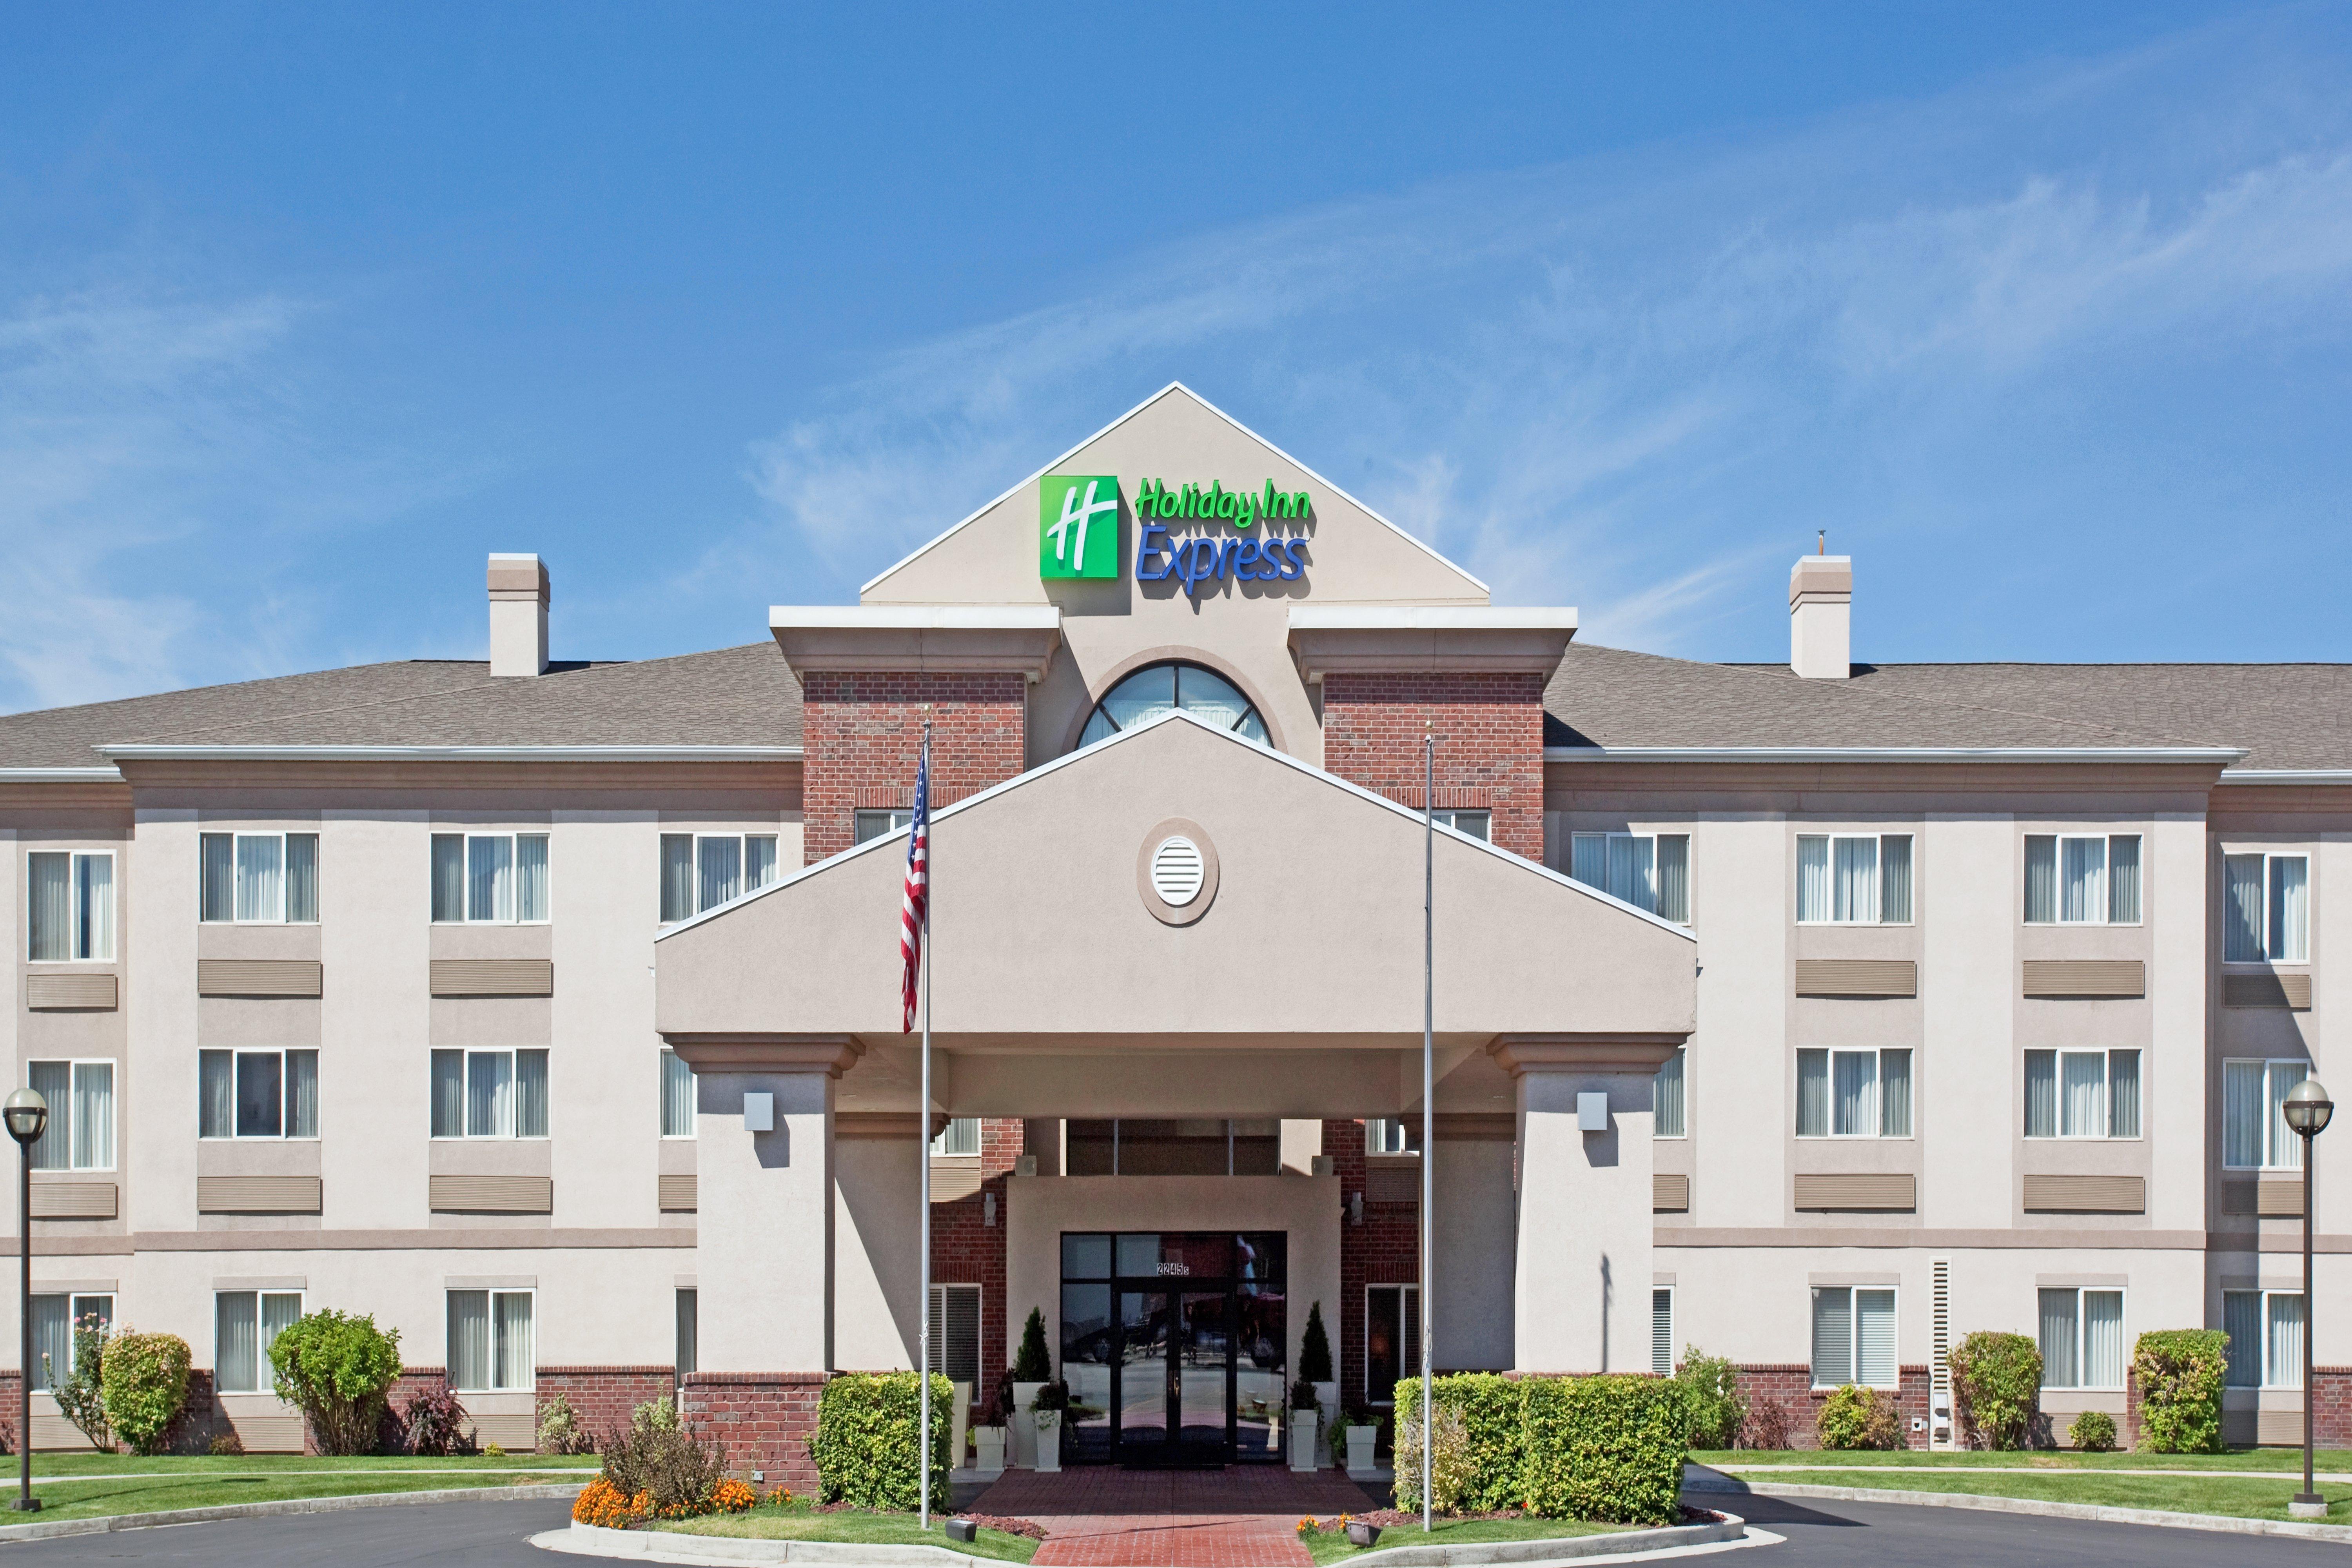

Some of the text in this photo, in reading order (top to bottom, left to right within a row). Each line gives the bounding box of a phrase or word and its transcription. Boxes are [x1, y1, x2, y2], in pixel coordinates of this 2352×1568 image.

[1135, 478, 1310, 528] Holiday Inn
[1135, 524, 1307, 596] Express
